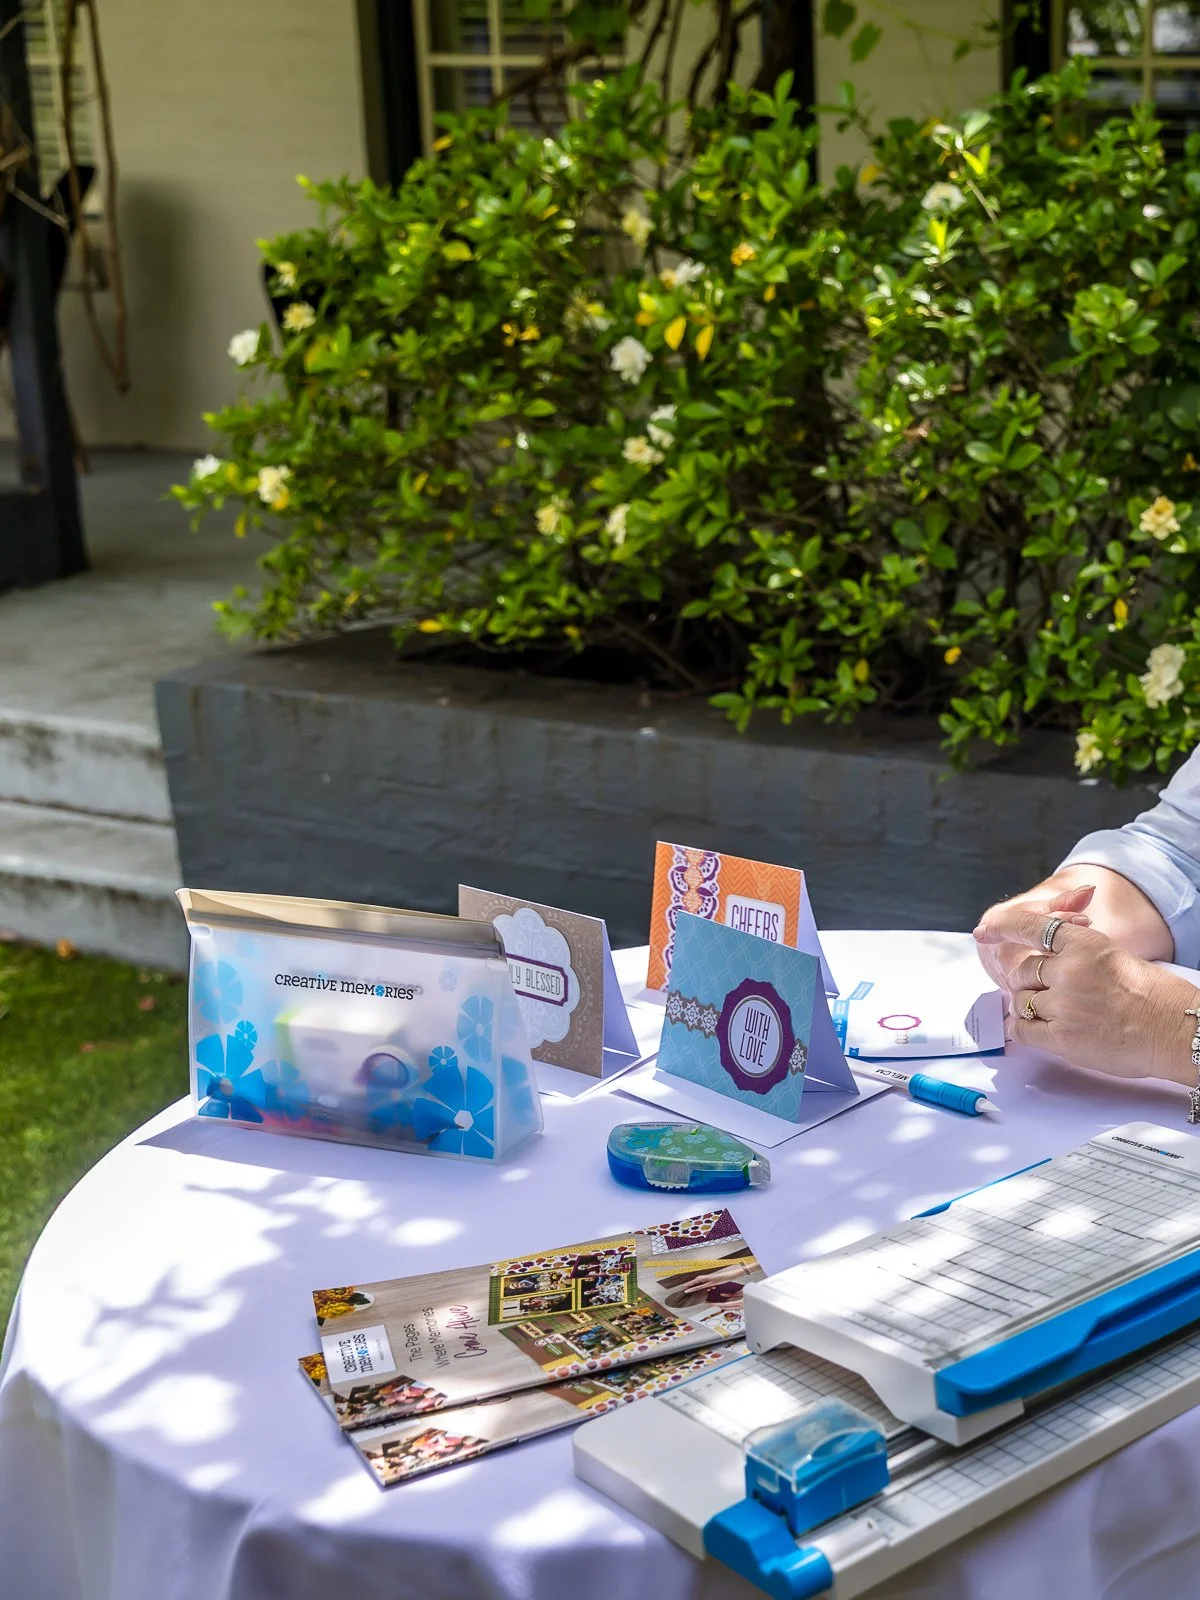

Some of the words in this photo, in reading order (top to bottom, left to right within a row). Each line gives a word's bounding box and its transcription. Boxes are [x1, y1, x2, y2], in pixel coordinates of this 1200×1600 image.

[731, 904, 779, 941] CHEERS
[526, 968, 560, 996] BLESSED
[745, 1007, 771, 1040] WITH
[739, 1032, 767, 1067] LOVE
[422, 1307, 443, 1344] Memories
[446, 1304, 480, 1330] Alive
[403, 1323, 420, 1348] Pages
[453, 1332, 488, 1359] Come
[409, 1347, 424, 1363] The
[433, 1343, 450, 1368] Where
